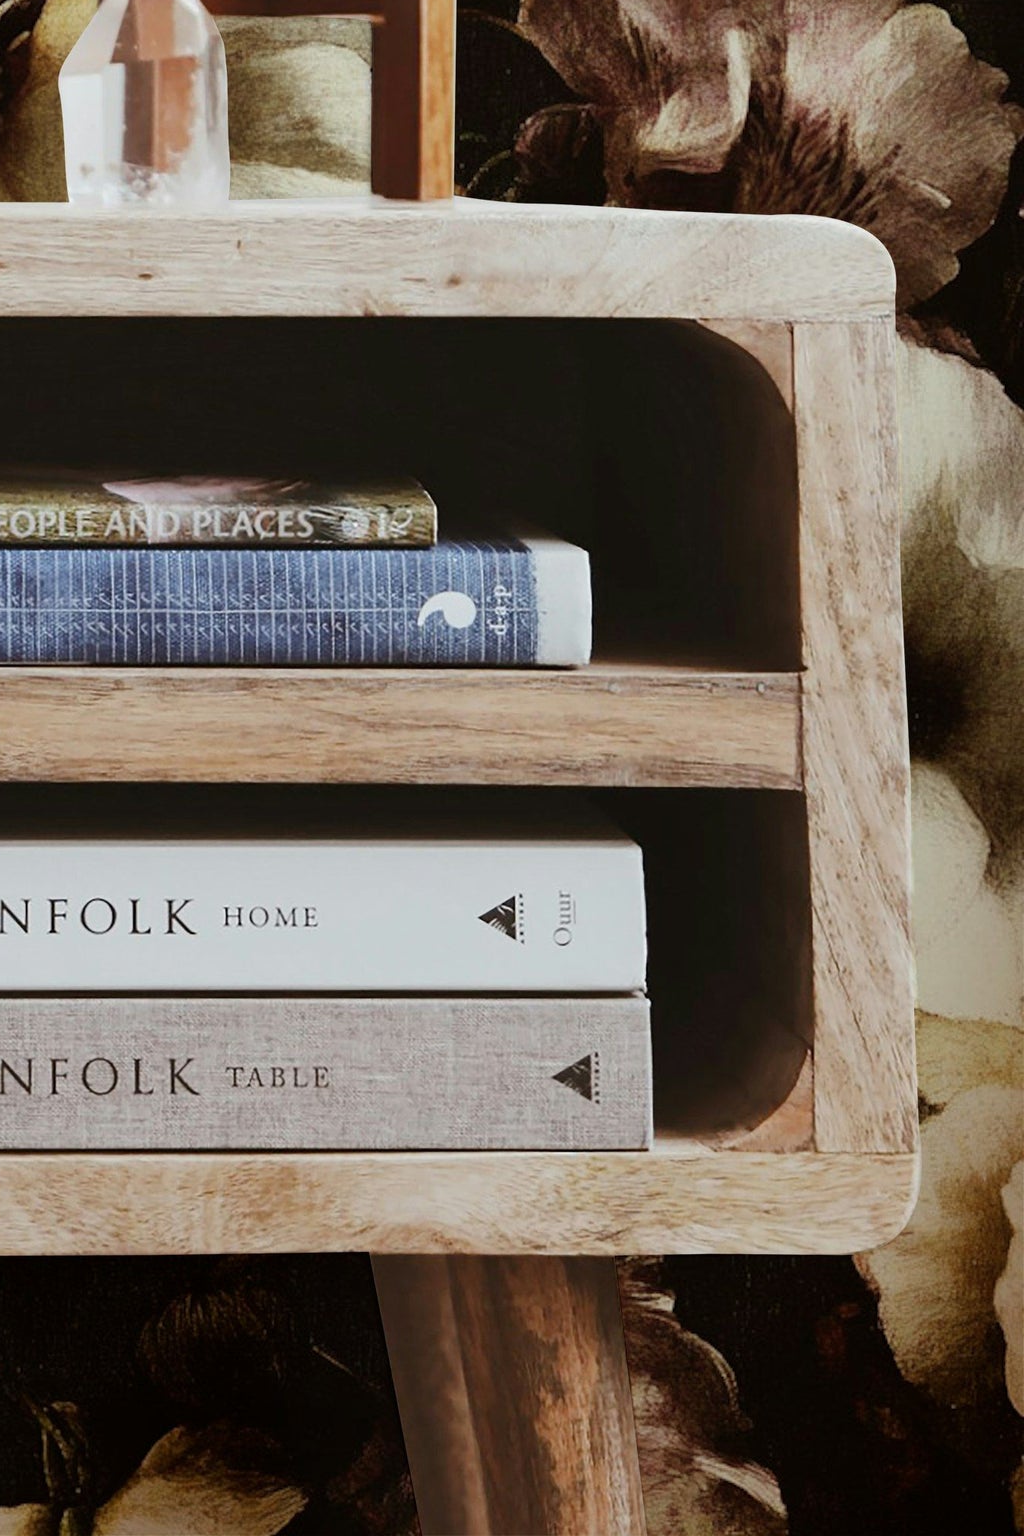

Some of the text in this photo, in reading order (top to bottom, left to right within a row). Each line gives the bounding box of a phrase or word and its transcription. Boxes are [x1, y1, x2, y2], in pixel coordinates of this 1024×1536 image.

[104, 510, 182, 539] AND
[192, 510, 315, 540] PLACES
[222, 906, 320, 928] HOME
[225, 1066, 331, 1090] TABLE
